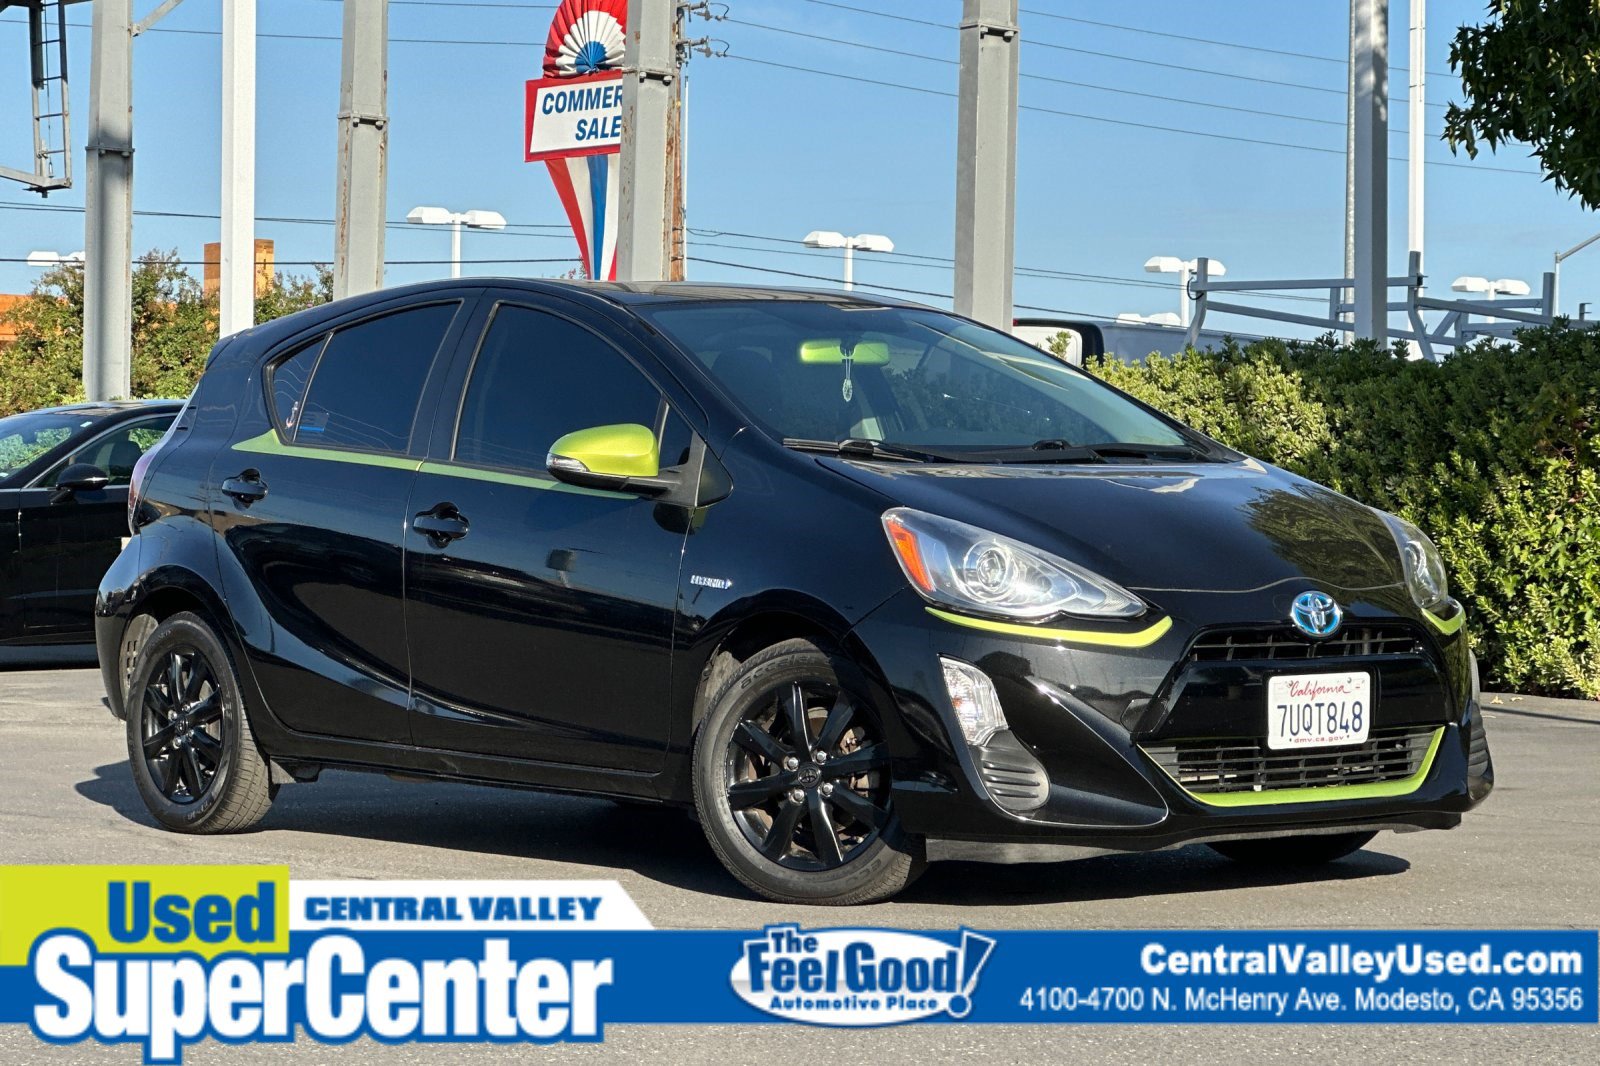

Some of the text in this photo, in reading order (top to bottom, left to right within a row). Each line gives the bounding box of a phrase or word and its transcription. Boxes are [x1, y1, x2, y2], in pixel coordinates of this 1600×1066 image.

[575, 115, 621, 141] SALE
[1290, 681, 1351, 701] California
[1277, 701, 1363, 737] 7UQT848
[1294, 735, 1344, 744] dmv.ca.gov
